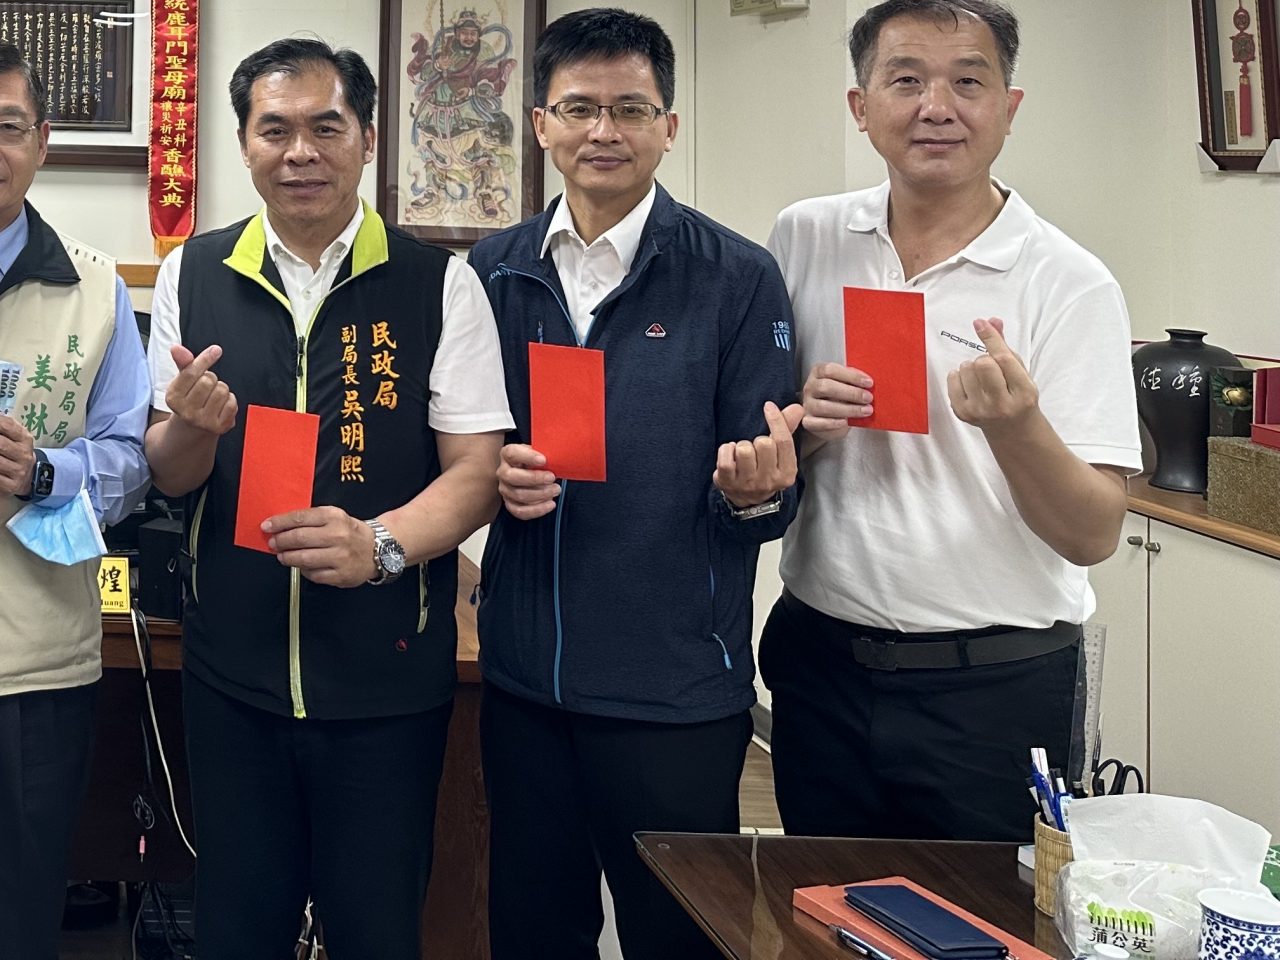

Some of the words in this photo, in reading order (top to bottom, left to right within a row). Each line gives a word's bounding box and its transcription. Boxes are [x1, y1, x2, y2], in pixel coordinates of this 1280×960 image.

[174, 102, 188, 147] 辛丑科
[158, 147, 187, 208] 香醮大典
[940, 330, 988, 353] PORSC
[370, 321, 400, 410] 民政局
[0, 368, 10, 398] 1000
[7, 369, 20, 398] 1000
[50, 334, 84, 443] 民政局局
[100, 565, 123, 593] 煌
[1087, 926, 1153, 954] 蒲公英
